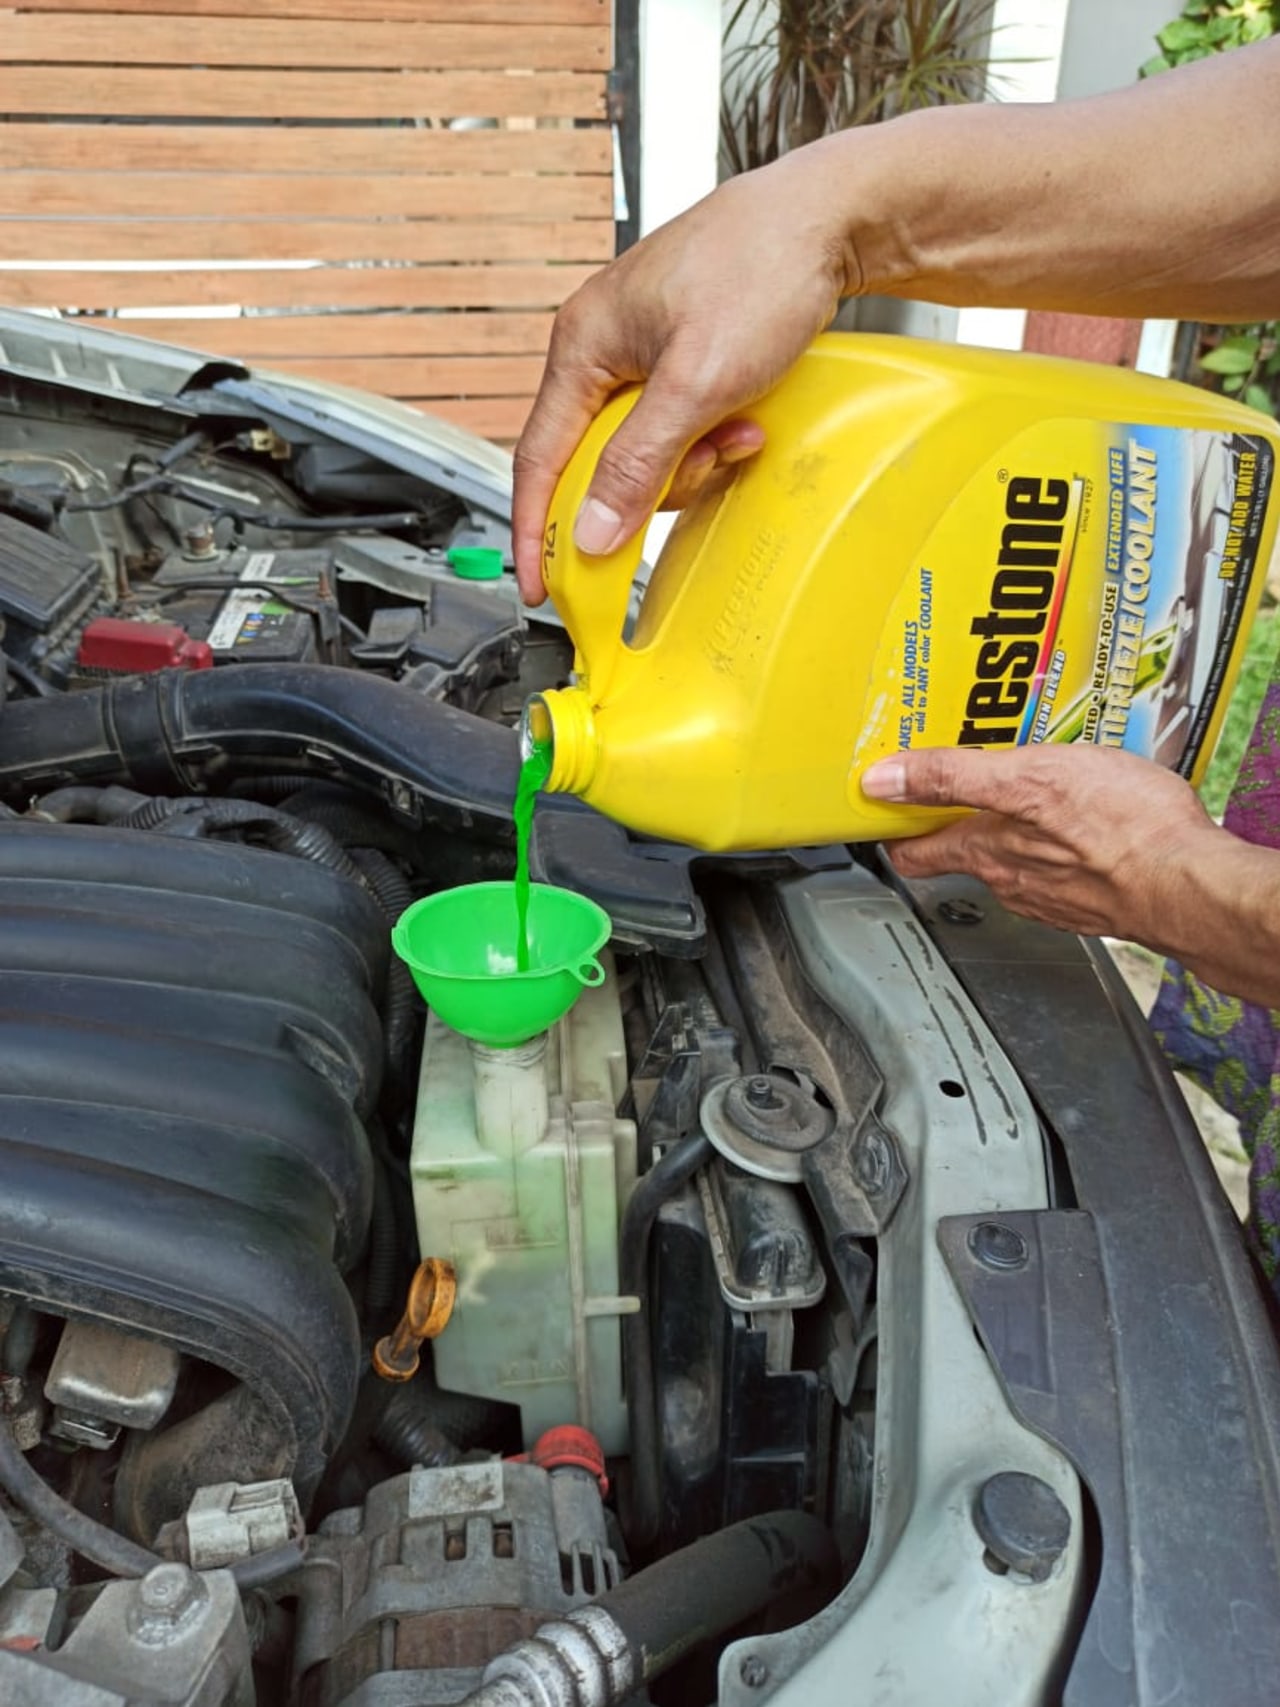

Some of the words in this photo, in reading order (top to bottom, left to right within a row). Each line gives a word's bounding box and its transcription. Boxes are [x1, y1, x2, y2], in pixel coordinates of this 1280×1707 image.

[1111, 451, 1124, 485] LIFE
[1236, 453, 1257, 497] WATER
[1107, 489, 1124, 571] EXTENDED
[1230, 501, 1249, 527] ADD
[1224, 531, 1243, 556] NOT
[1219, 561, 1237, 578] DO
[920, 567, 933, 631] COOLANT
[1101, 437, 1157, 748] TIFREEZE/COOLANT
[957, 476, 1070, 749] restone
[904, 620, 918, 679] MODELS
[922, 634, 931, 664] color
[1083, 708, 1098, 742] UTED
[1093, 586, 1117, 689] READY-TO-USE
[902, 683, 916, 709] ALL
[917, 666, 929, 693] ANY
[918, 696, 927, 708] to
[1032, 704, 1052, 744] ISION
[1046, 650, 1066, 699] BLEND
[916, 711, 926, 733] add
